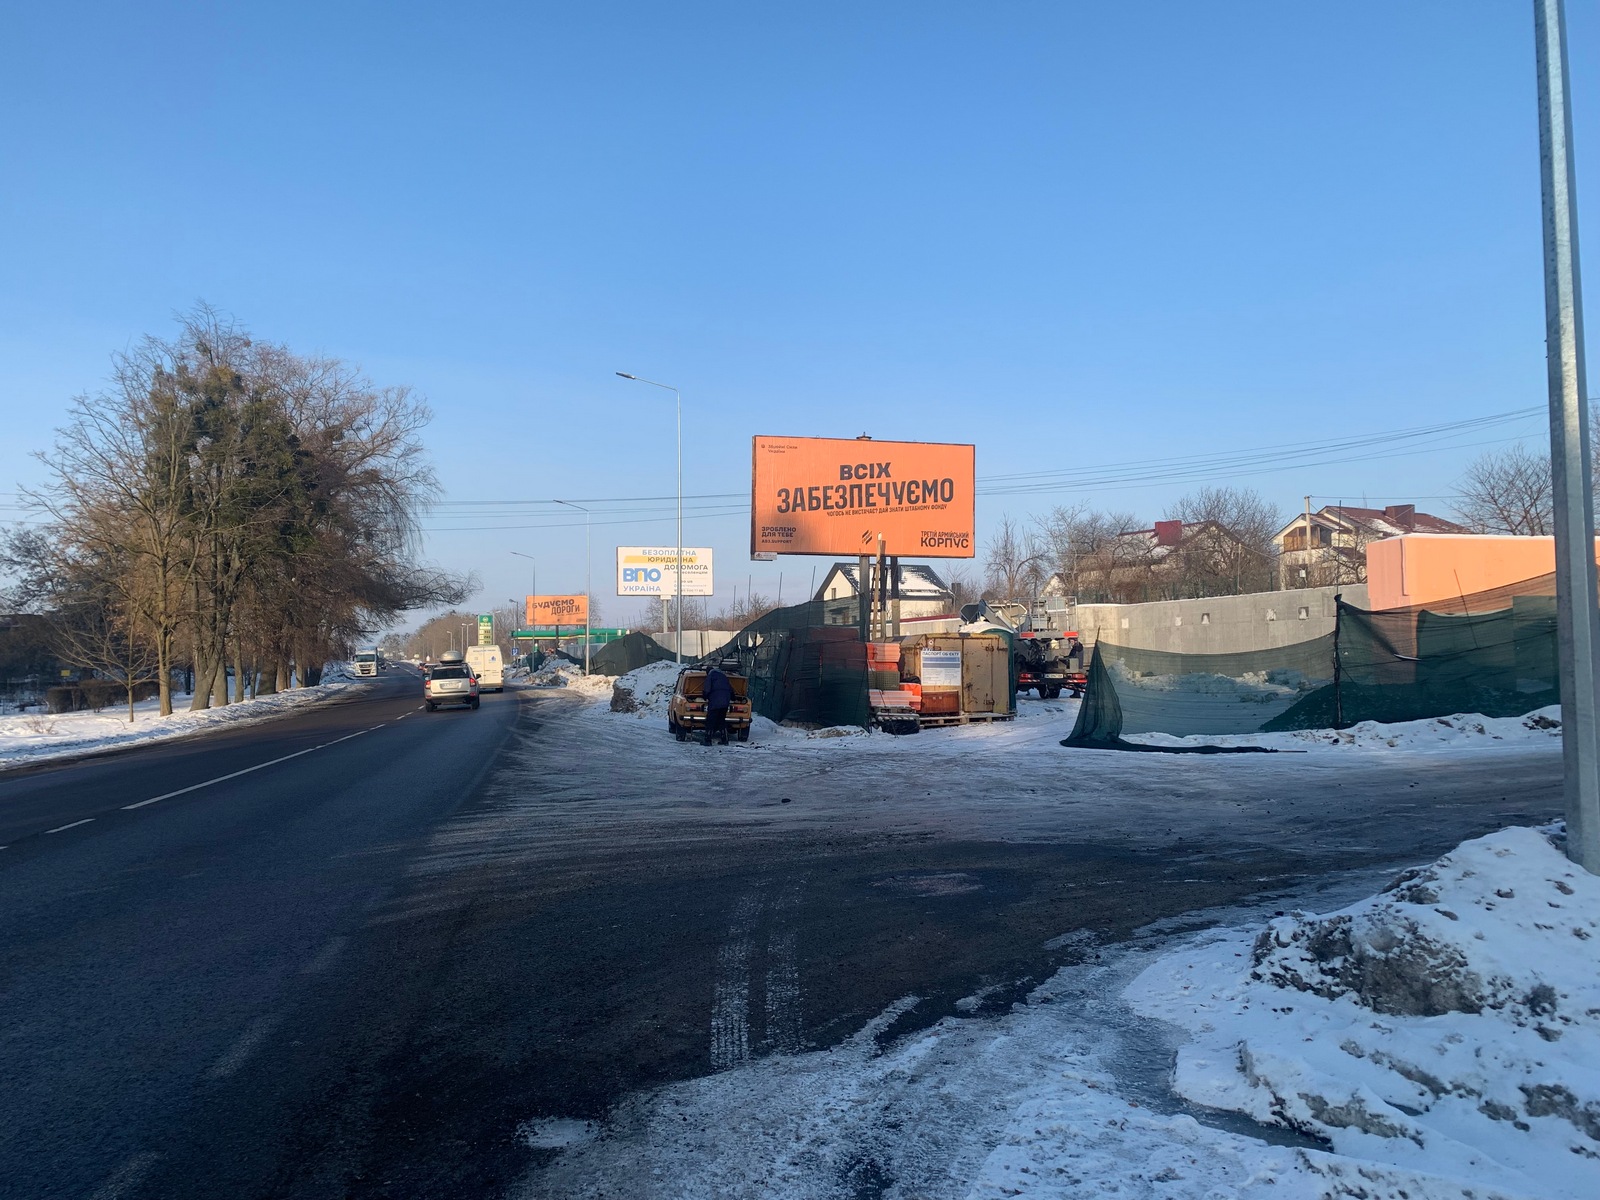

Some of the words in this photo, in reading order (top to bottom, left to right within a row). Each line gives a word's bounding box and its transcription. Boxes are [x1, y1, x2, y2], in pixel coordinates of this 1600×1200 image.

[839, 462, 891, 481] ВСІХ
[776, 478, 954, 513] ЗАБЕЗПЕЧУЄМО
[921, 537, 969, 548] КОРПУС
[623, 567, 661, 582] ВПО
[623, 584, 661, 592] УКРАЇНА
[532, 599, 575, 609] БУДУЄМО
[551, 604, 580, 615] ДОРОГИ
